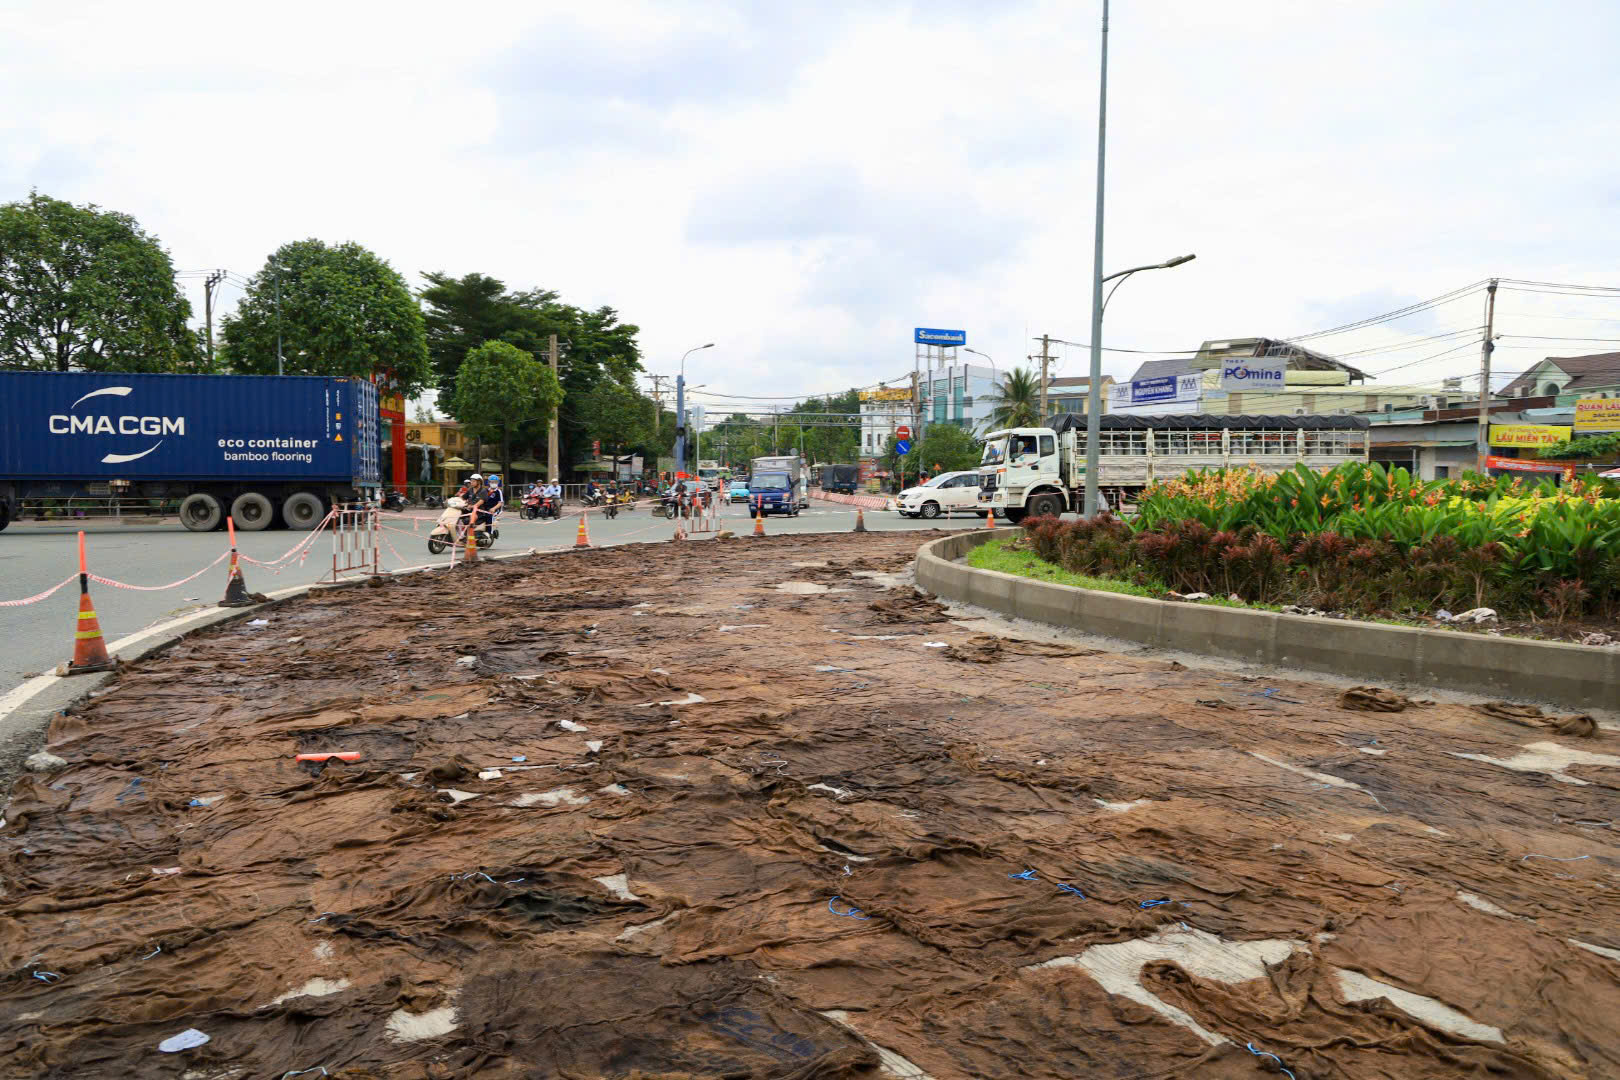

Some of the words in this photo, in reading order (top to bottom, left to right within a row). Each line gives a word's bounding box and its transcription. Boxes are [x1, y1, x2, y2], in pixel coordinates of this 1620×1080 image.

[49, 414, 116, 436] CMA
[118, 415, 185, 436] CGM
[217, 438, 245, 449] eco
[247, 437, 319, 449] container
[224, 450, 269, 462] bamboo
[271, 450, 313, 464] flooring
